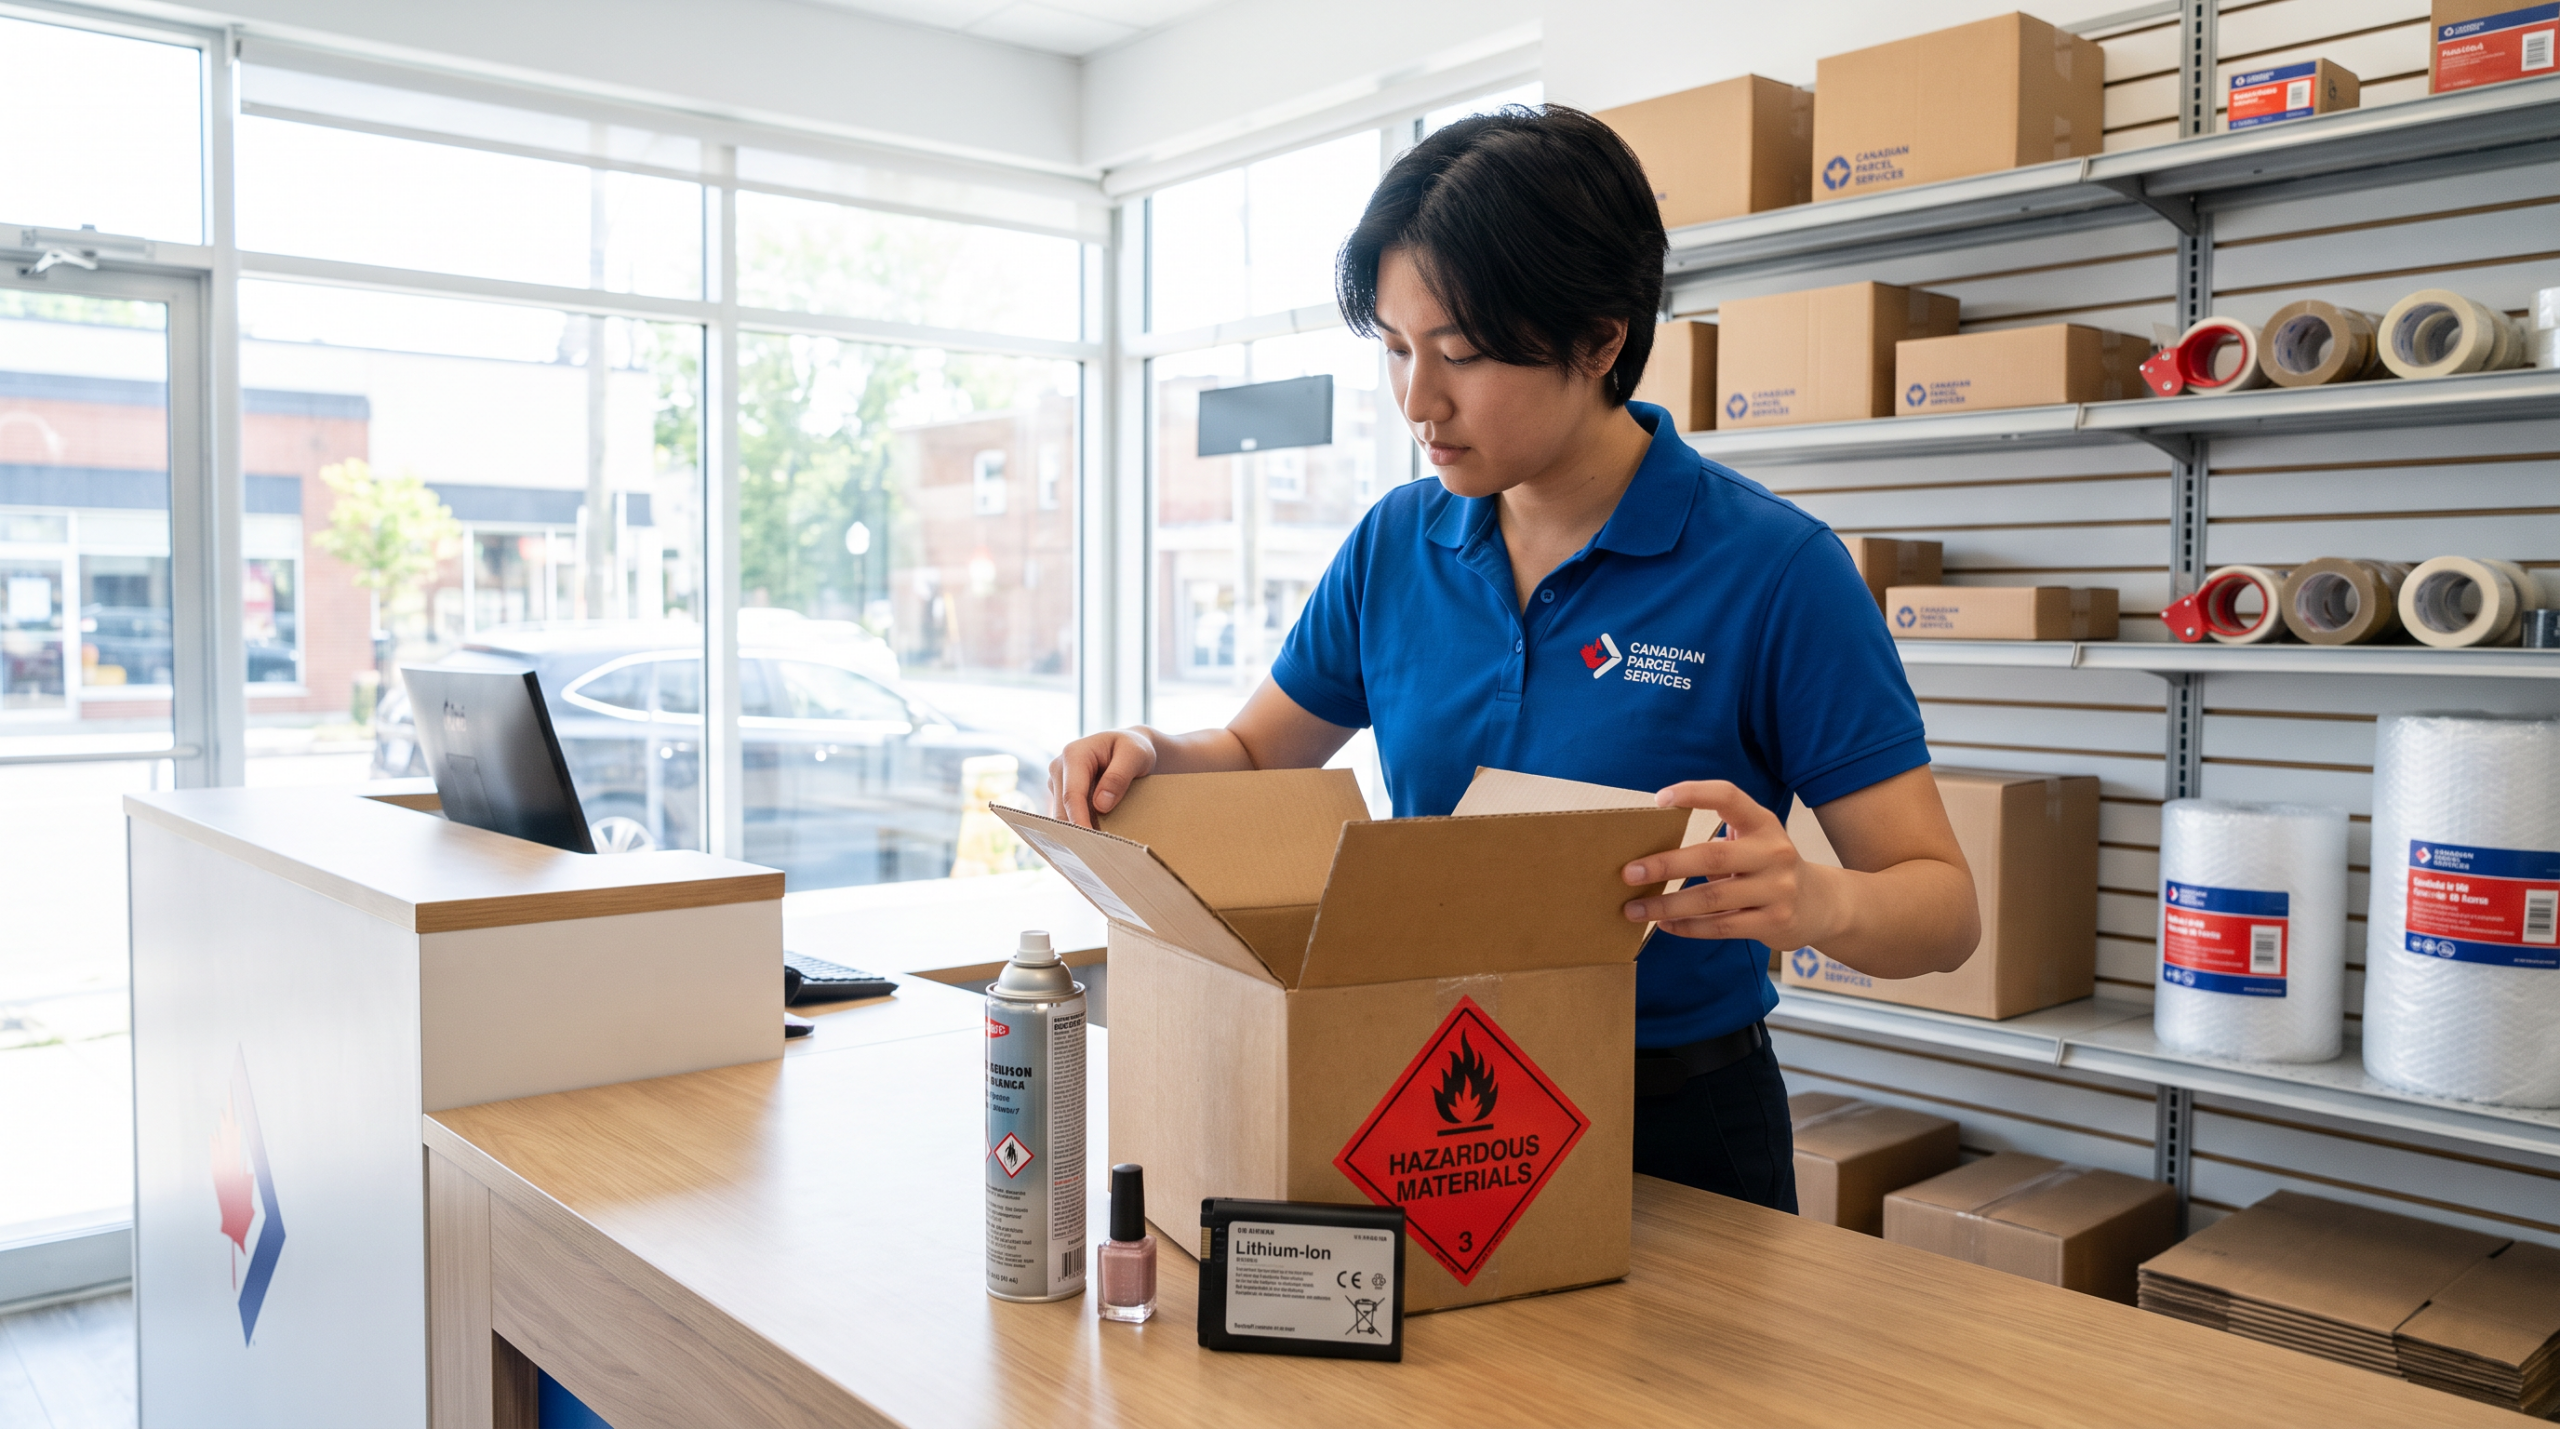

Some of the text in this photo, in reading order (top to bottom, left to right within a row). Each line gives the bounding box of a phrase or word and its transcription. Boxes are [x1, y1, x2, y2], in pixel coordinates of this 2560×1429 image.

[1855, 145, 1909, 162] CANADIAN
[1630, 642, 1705, 664] CANADIAN
[1626, 655, 1679, 674] PARCEL
[1623, 669, 1692, 690] SERVICES
[1389, 1134, 1540, 1176] HAZARDOUS
[1396, 1162, 1532, 1203] MATERIALS
[1236, 1240, 1331, 1260] Lithium-Ion
[1458, 1231, 1473, 1253] 3
